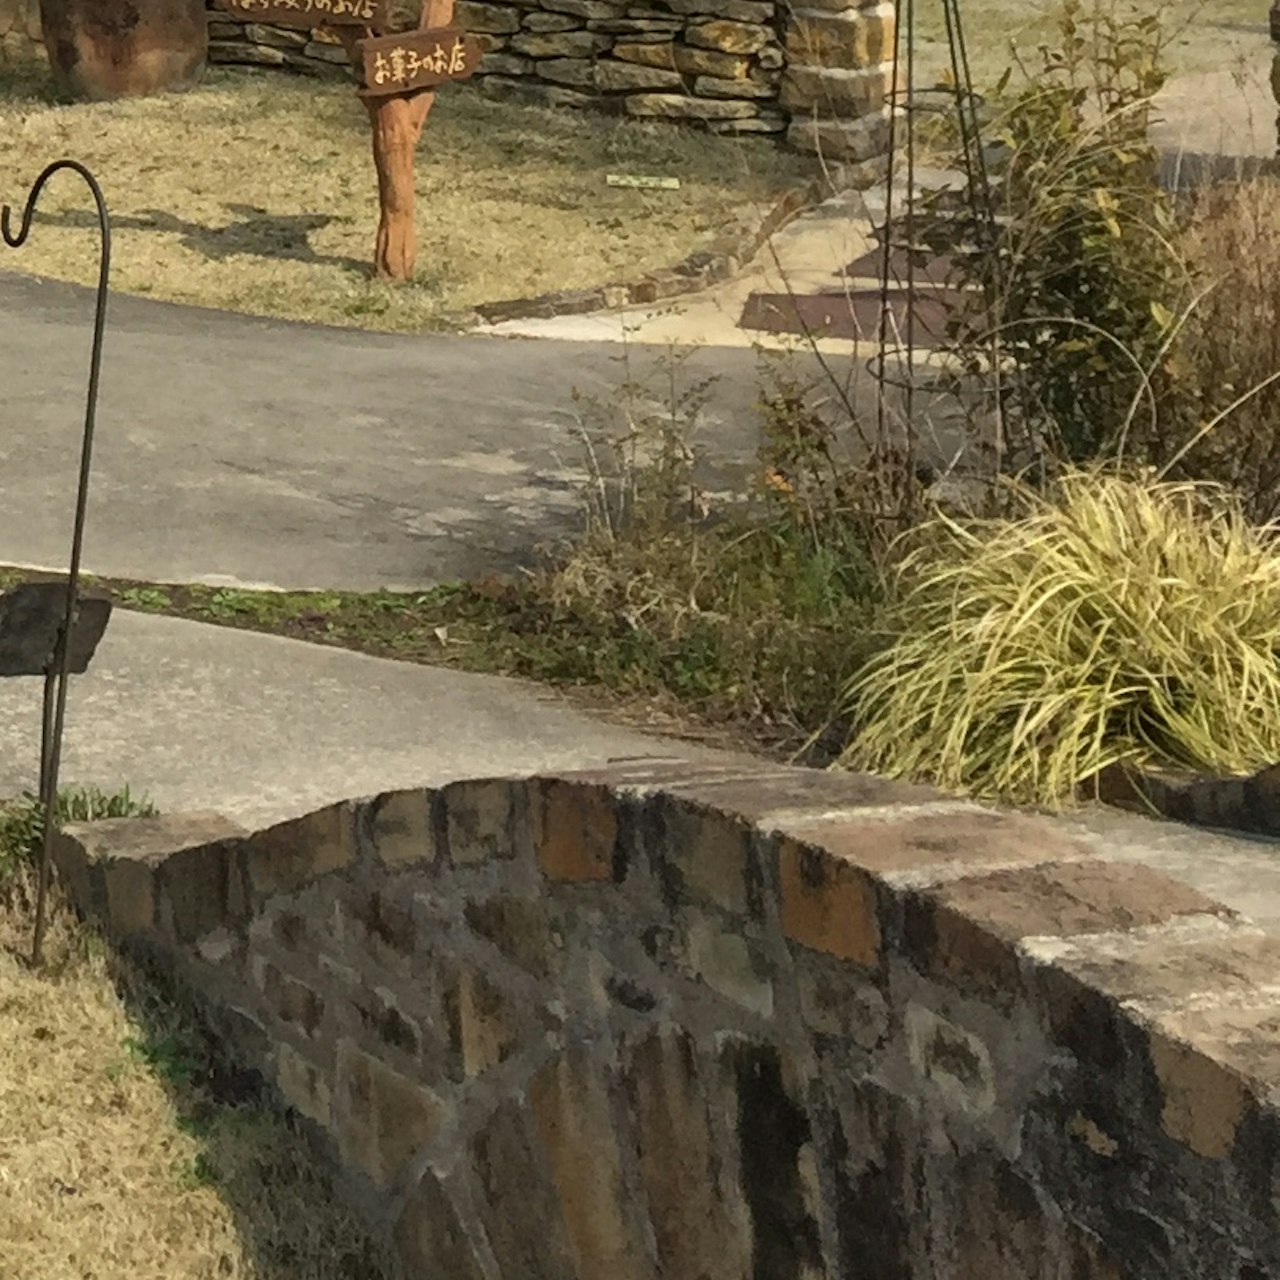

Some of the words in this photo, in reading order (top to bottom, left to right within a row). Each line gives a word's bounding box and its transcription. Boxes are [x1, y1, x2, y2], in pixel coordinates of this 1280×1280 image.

[374, 36, 465, 84] お菓子のお店
